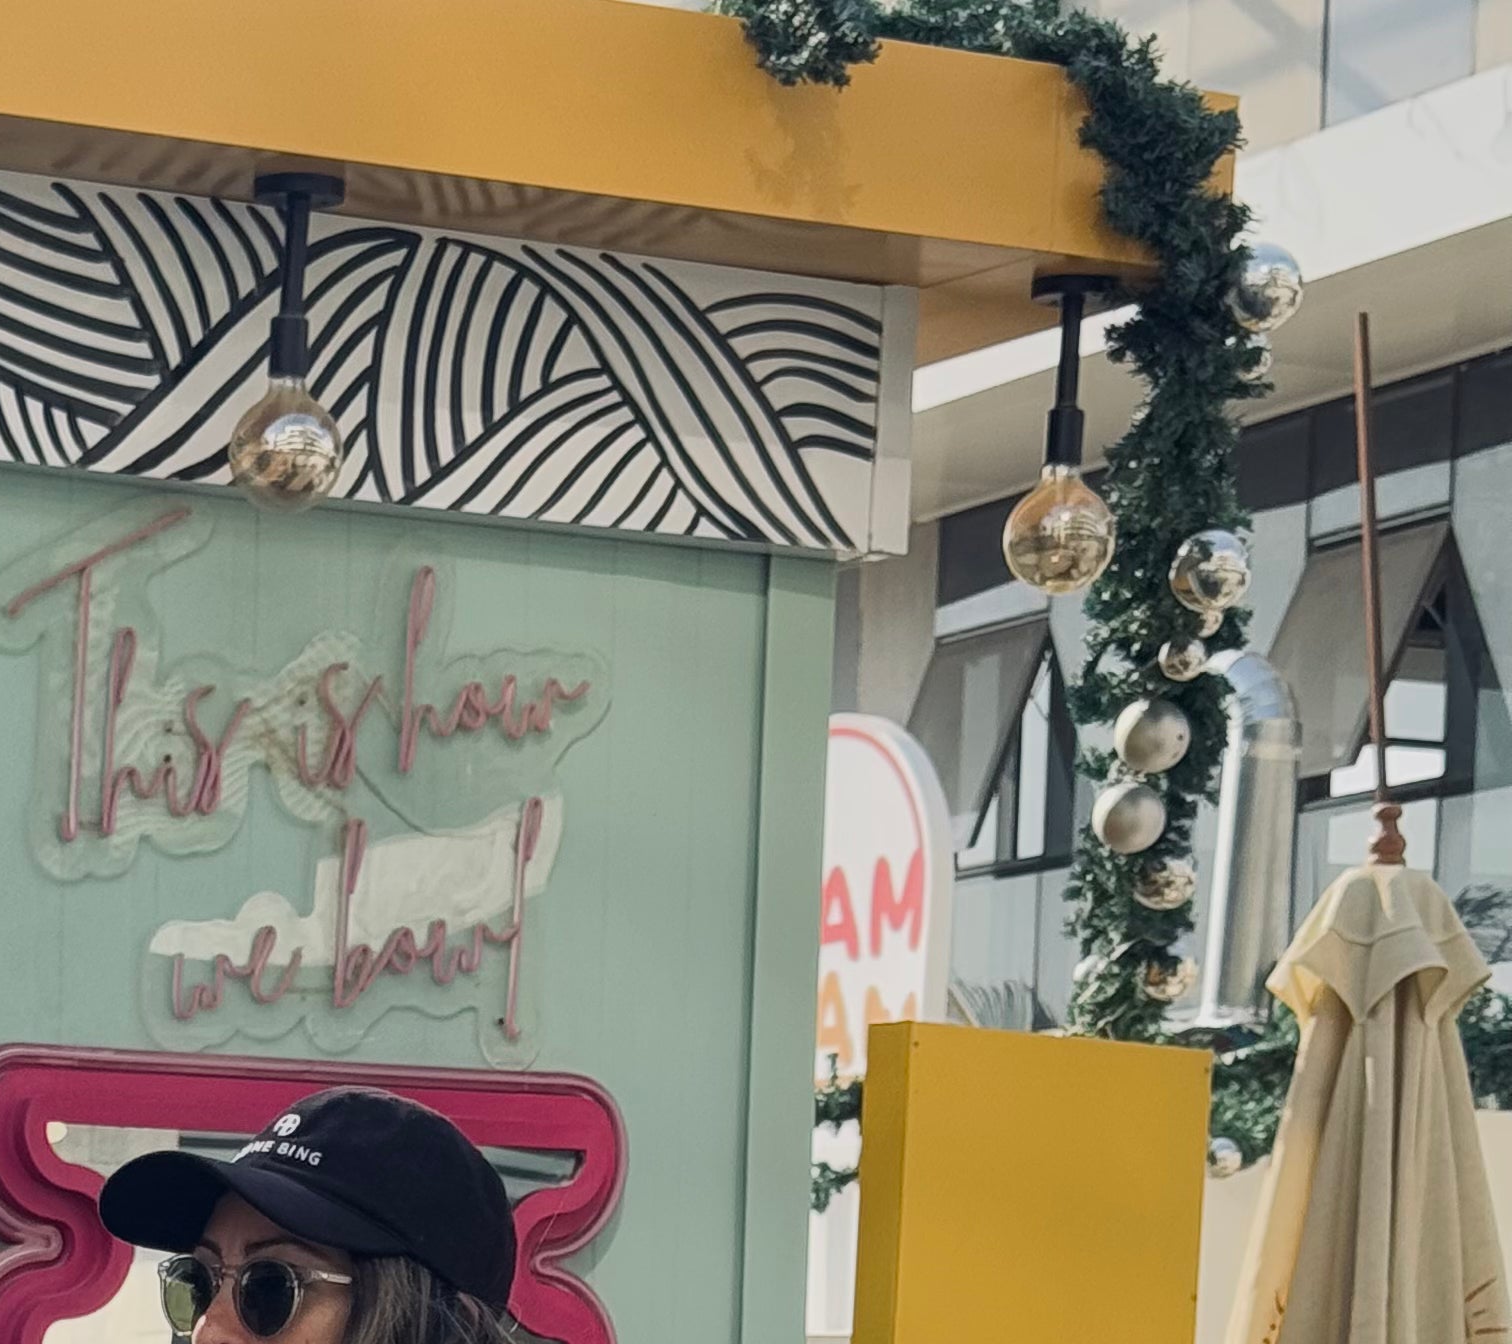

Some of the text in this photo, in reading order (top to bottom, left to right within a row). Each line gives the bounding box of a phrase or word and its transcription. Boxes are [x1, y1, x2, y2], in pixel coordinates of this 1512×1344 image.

[4, 506, 591, 842] This is how
[170, 797, 544, 1041] we bowl
[277, 1142, 323, 1166] BING
